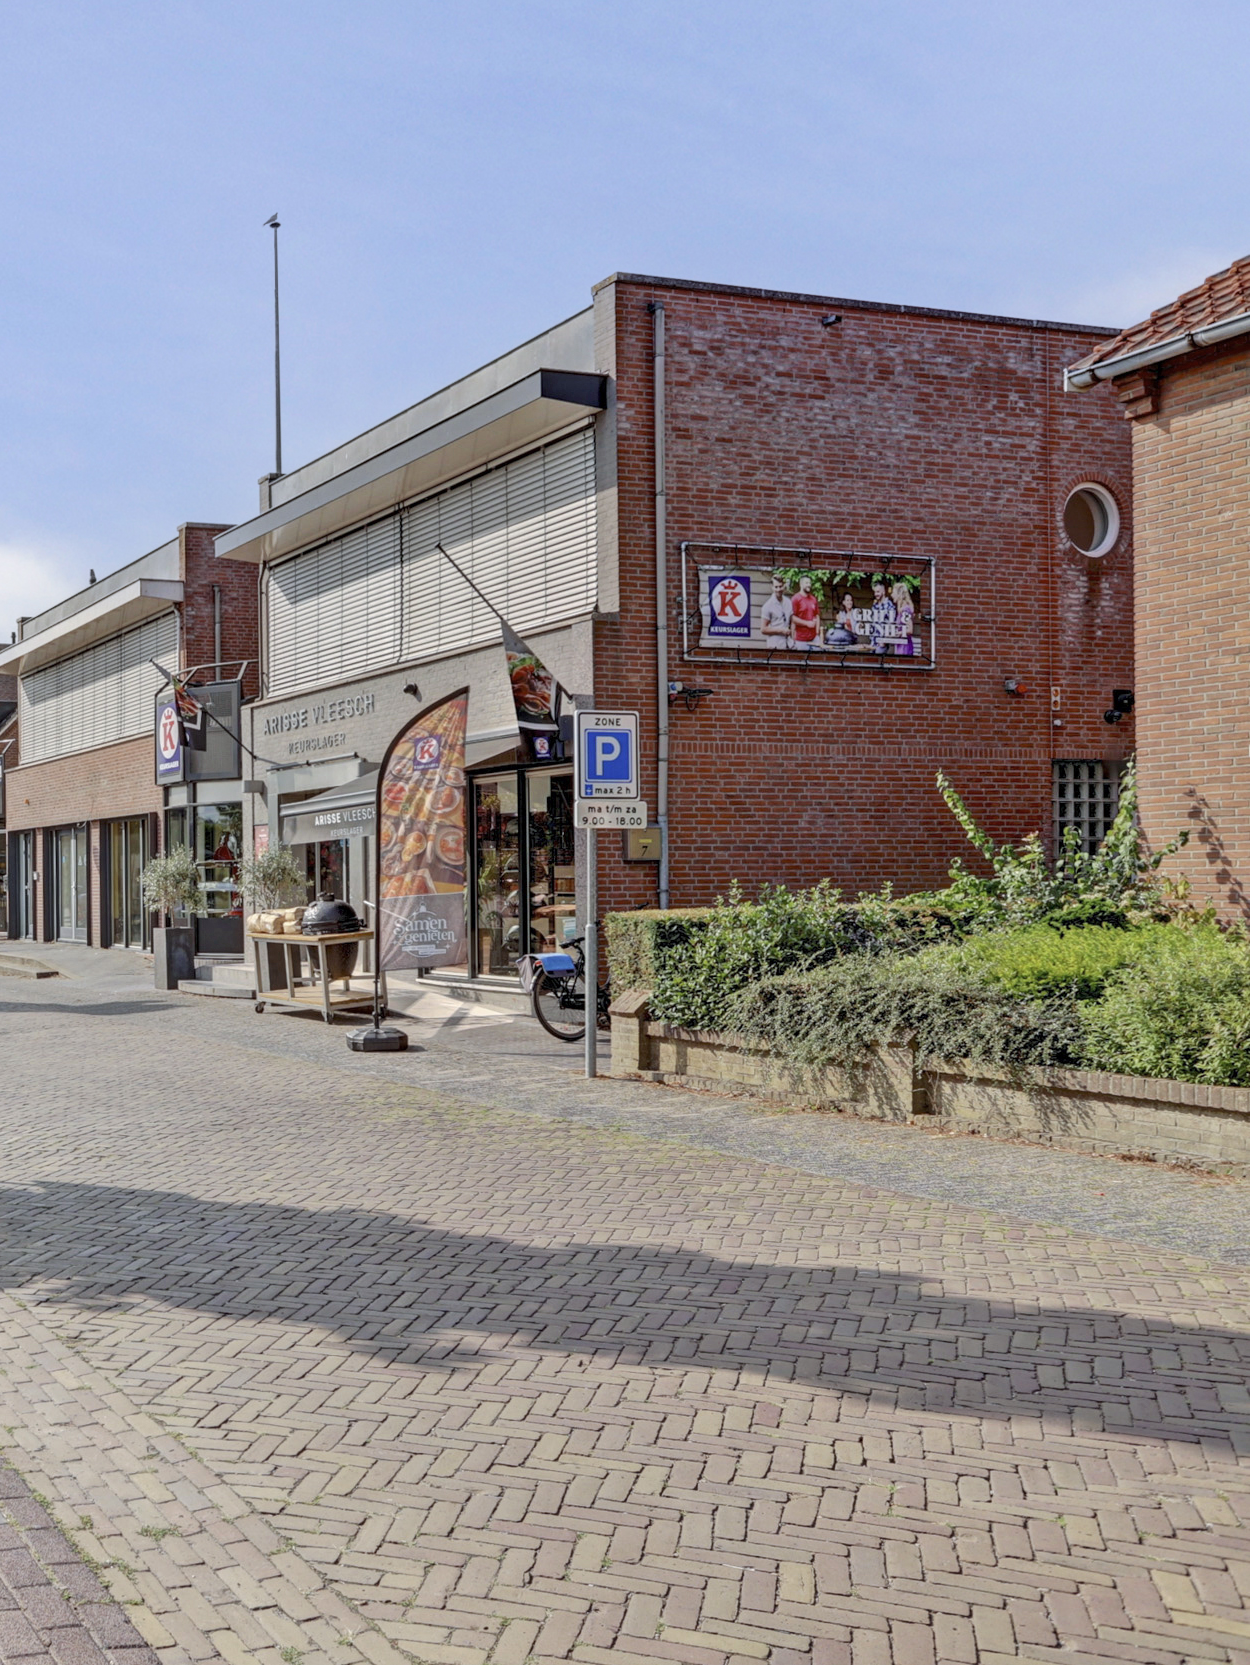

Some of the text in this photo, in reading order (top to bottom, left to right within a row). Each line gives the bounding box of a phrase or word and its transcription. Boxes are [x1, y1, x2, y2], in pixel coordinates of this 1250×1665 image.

[717, 591, 742, 617] K
[853, 608, 912, 624] GRILL &
[710, 626, 749, 634] KEURSLAGER
[855, 622, 908, 638] GENIET
[263, 693, 375, 735] ARISSE VLEESCH
[594, 718, 622, 727] ZONE
[162, 720, 176, 752] K
[288, 733, 346, 755] KEURSLAGER
[418, 743, 435, 760] K
[595, 735, 621, 776] P
[595, 786, 631, 795] max 2 h
[588, 805, 637, 814] ma t/m za
[314, 812, 341, 827] ARISSE
[582, 817, 605, 826] 9.00
[616, 817, 643, 826] 18.00
[330, 826, 364, 837] KEURSLAGER
[641, 845, 649, 857] 7
[392, 917, 448, 936] Samen
